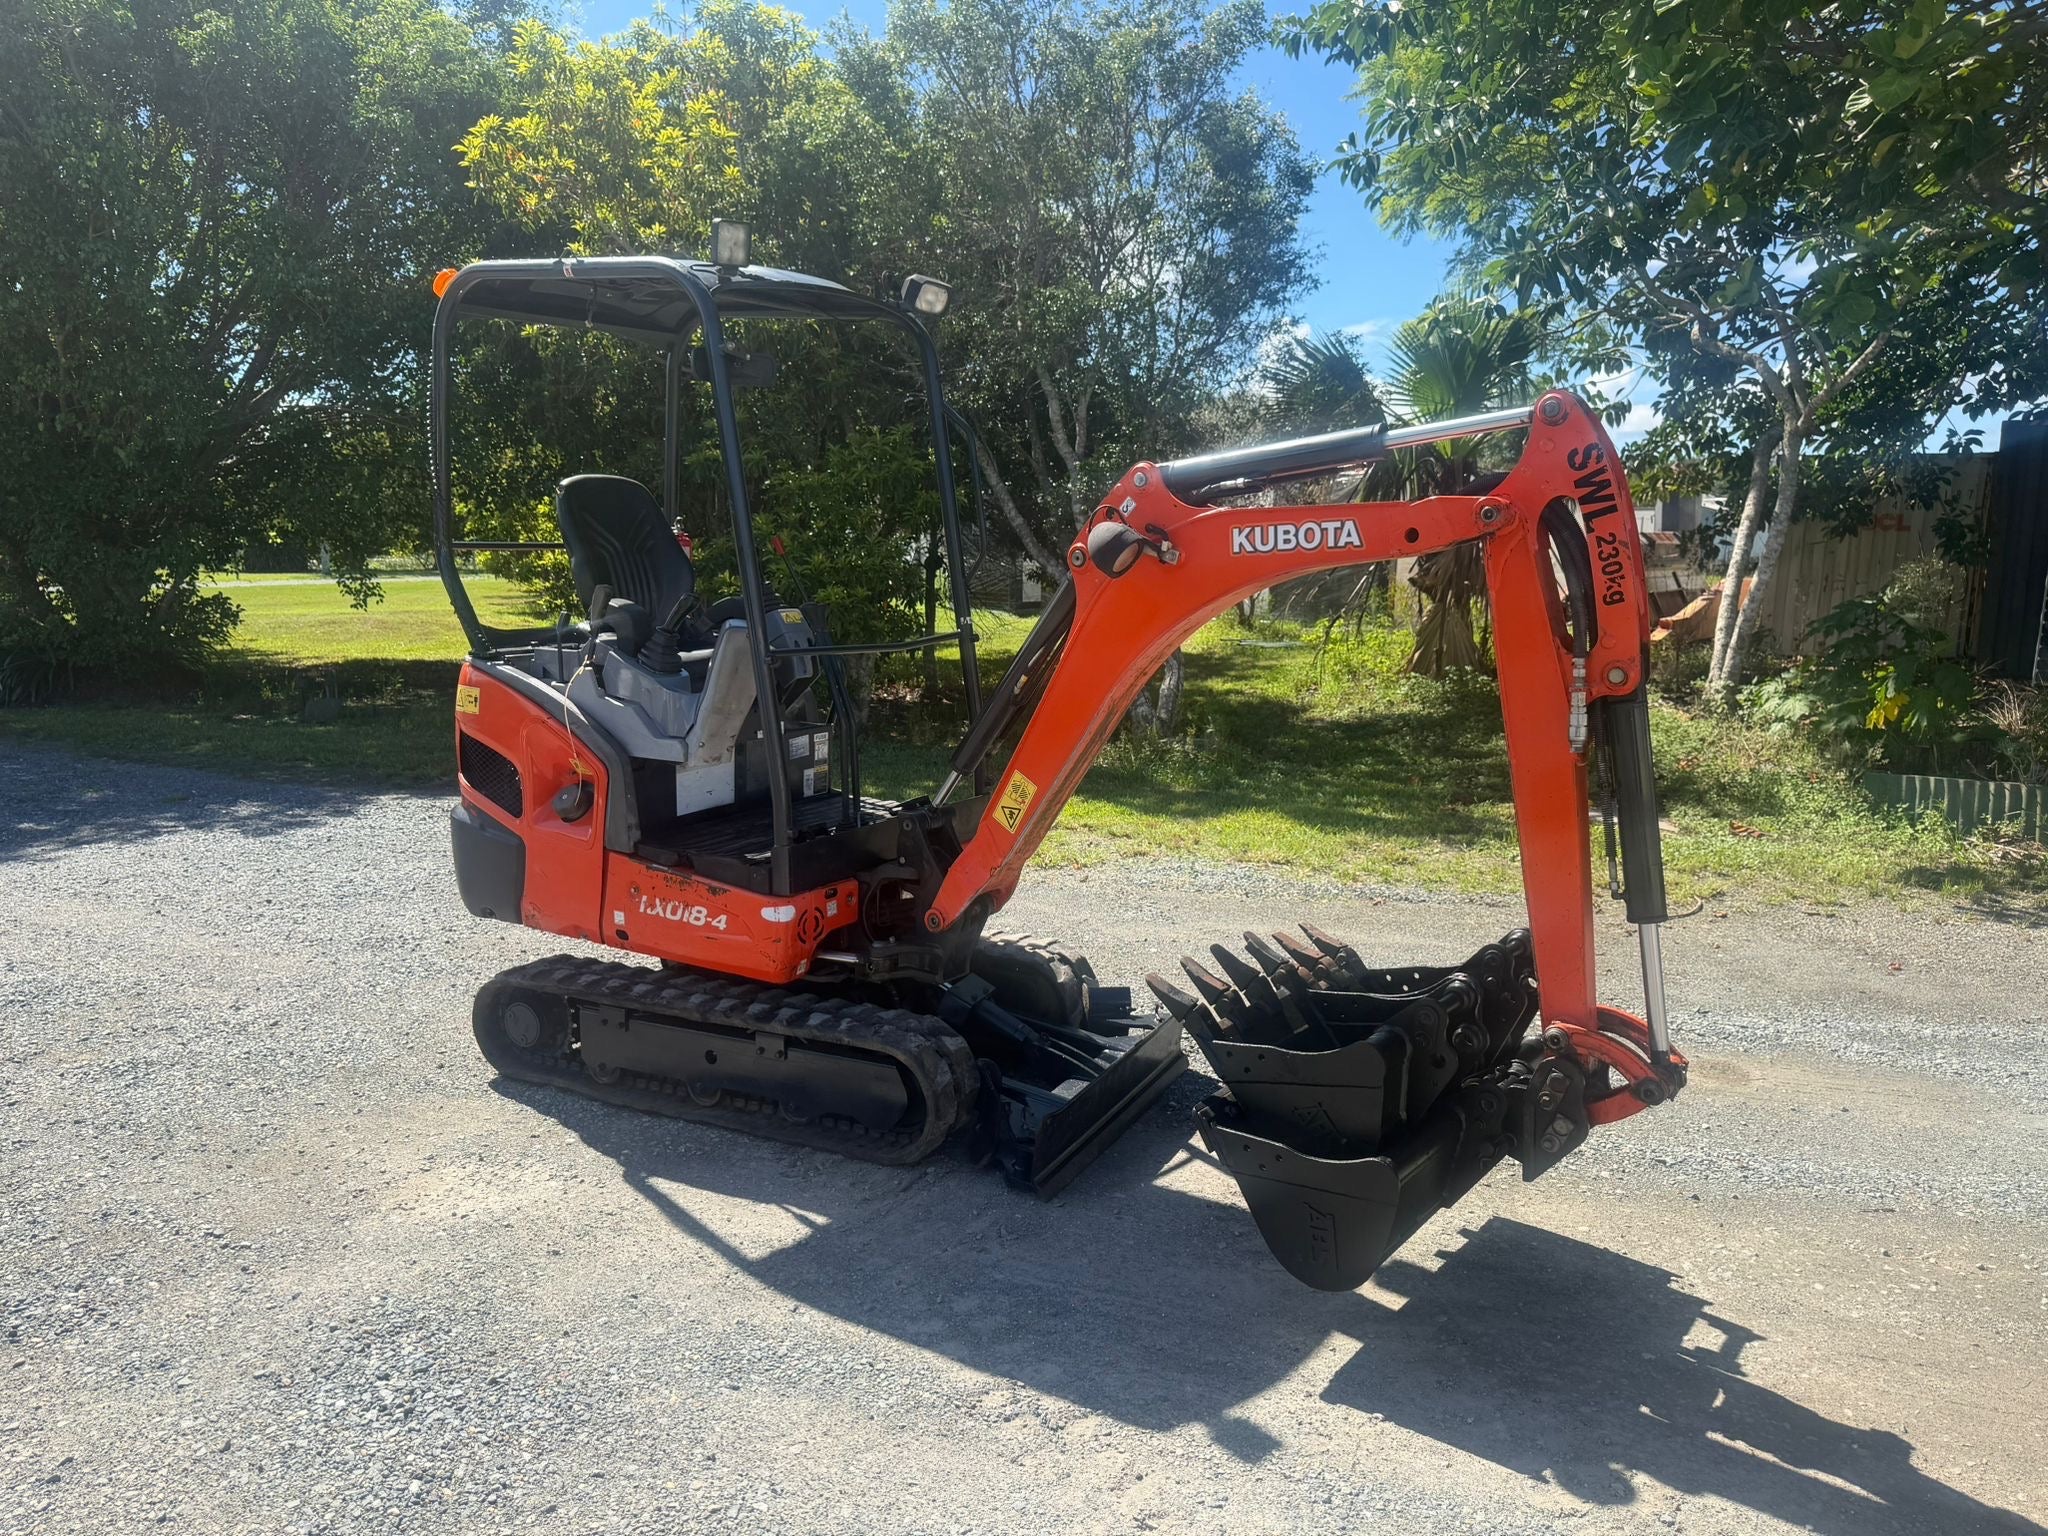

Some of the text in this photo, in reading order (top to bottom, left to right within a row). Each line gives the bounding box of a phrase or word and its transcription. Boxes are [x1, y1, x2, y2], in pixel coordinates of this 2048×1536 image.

[1231, 519, 1363, 554] KUBOTA
[1567, 442, 1626, 607] SWL 230kg
